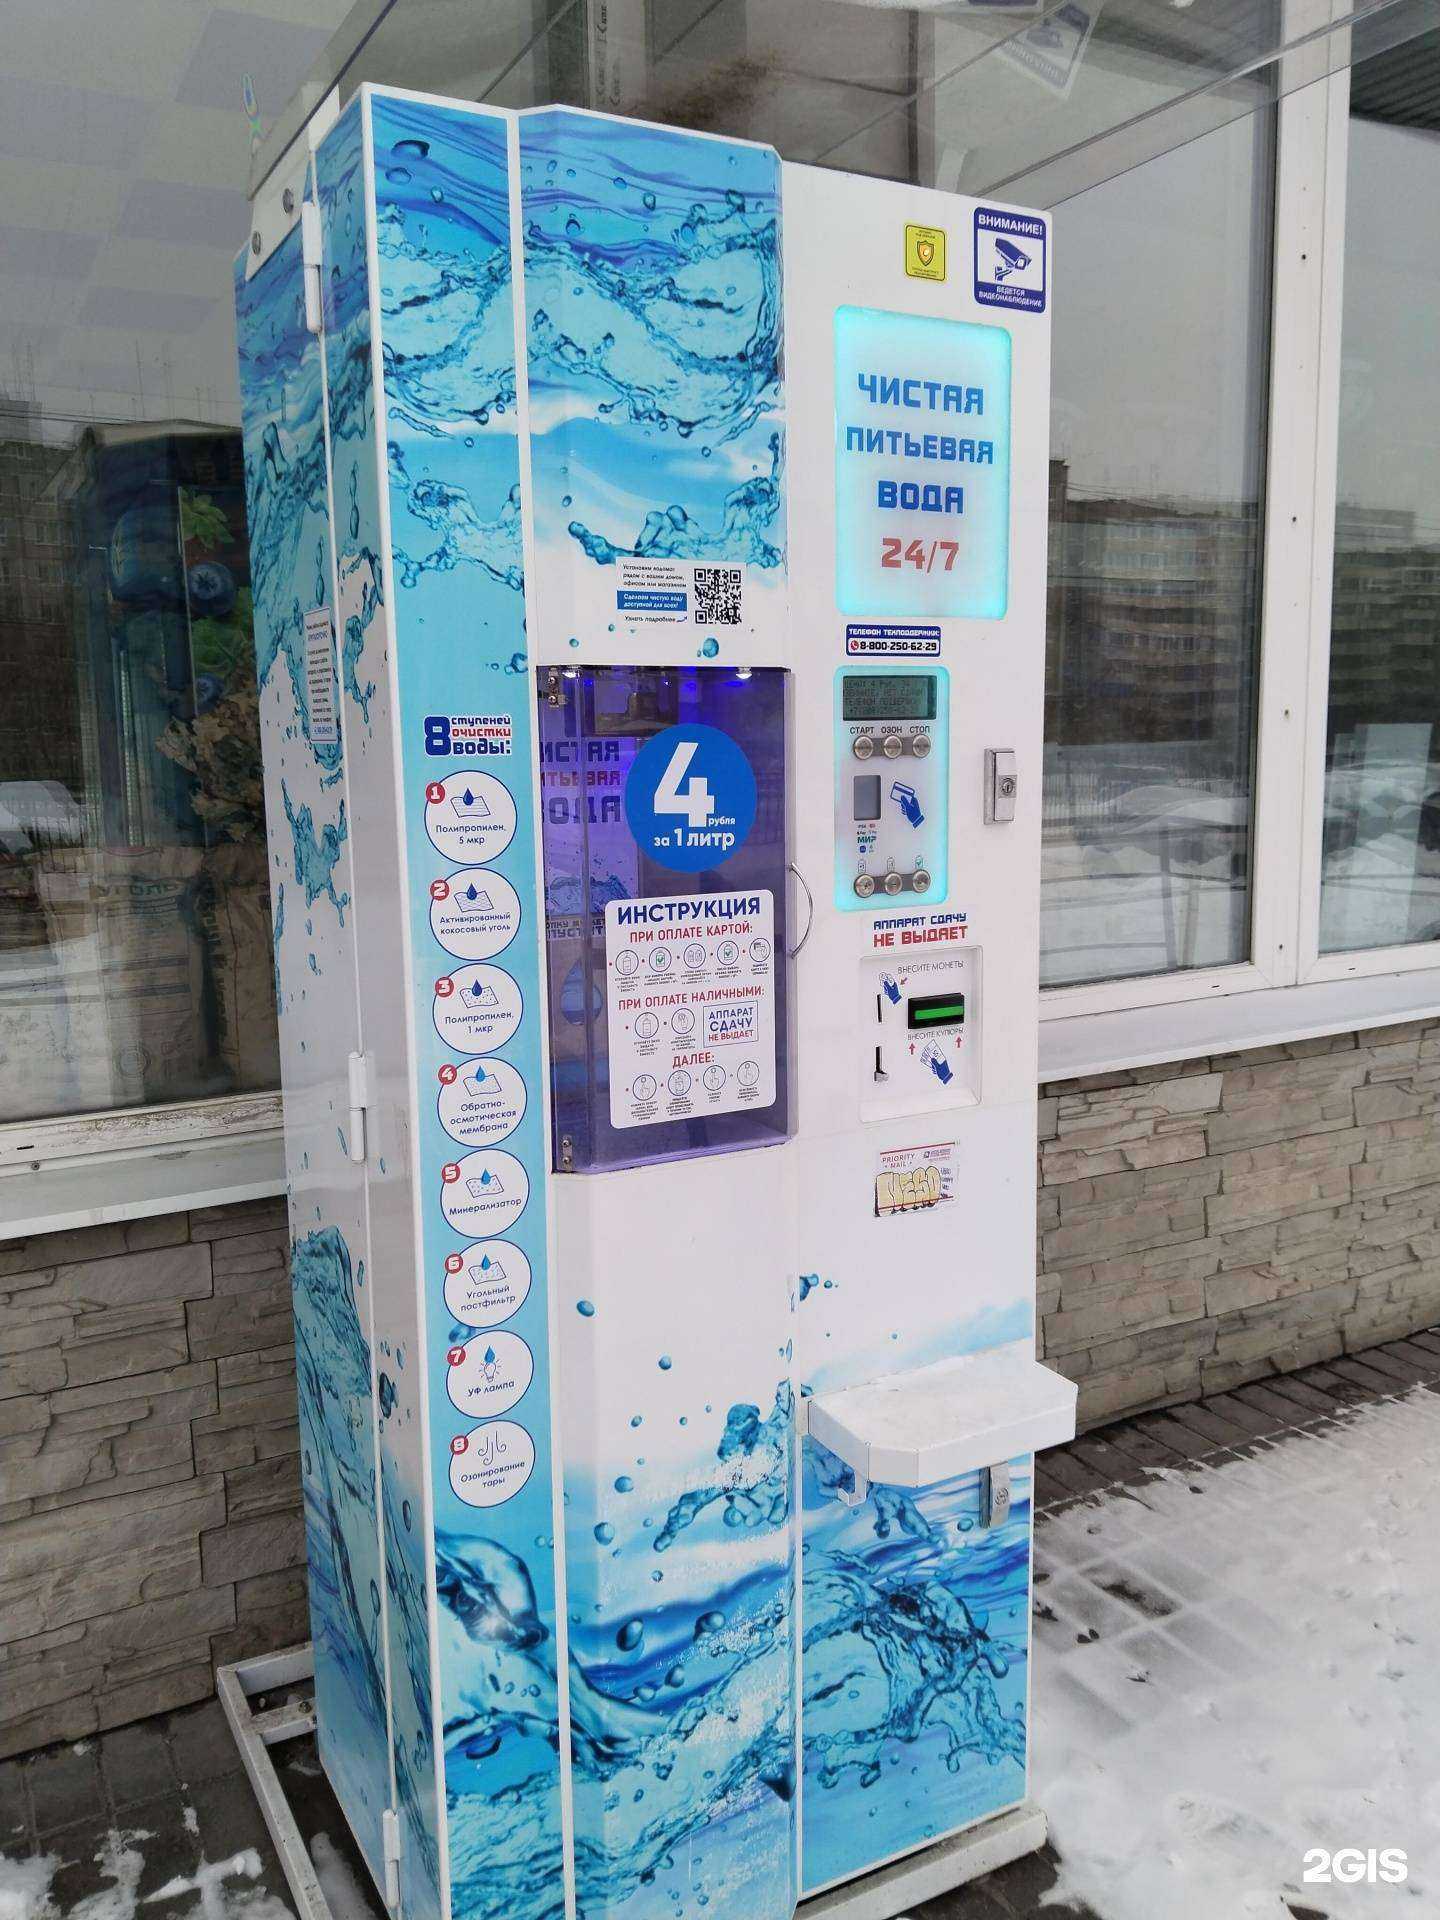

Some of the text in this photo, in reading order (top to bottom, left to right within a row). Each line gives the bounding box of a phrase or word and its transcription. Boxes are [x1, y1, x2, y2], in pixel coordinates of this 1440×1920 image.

[978, 214, 1042, 235] ВНИМАНИЕ!
[858, 373, 984, 415] ЧИСТАЯ
[846, 426, 994, 464] ПИТЬЕВАЯ
[878, 480, 963, 514] ВОДА
[881, 538, 960, 573] 24/7
[860, 641, 937, 651] 8-800-250-62-29
[424, 715, 511, 755] 8 ступеней
[452, 727, 511, 737] очистки
[849, 725, 930, 735] СТАРТ ОЗОН СТОП
[453, 738, 511, 754] воды:
[654, 742, 736, 828] 4 рубля
[430, 786, 440, 800] 1
[467, 837, 485, 845] мкр
[654, 828, 735, 851] за 1 литр
[433, 883, 445, 897] 2
[440, 911, 511, 924] Активированный
[618, 897, 760, 925] ИНСТРУКЦИЯ
[873, 912, 967, 930] АППАРАТ СДАЧУ
[440, 924, 511, 935] кокосовый уголь
[630, 921, 753, 943] ПРИ ОПЛАТЕ КАРТОЙ:
[873, 925, 968, 947] НЕ ВЫДАЕТ
[897, 960, 964, 974] ВНЕСИТЕ МОНЕТЫ
[438, 980, 451, 994] 3
[618, 986, 765, 1010] ПРИ ОПЛАТЕ НАЛИЧНЫМИ:
[708, 1007, 754, 1020] АППАРАТ
[475, 1026, 493, 1034] мкр
[709, 1017, 753, 1032] СДАЧУ
[708, 1029, 754, 1042] НЕ ВЫДАЕТ
[672, 1052, 715, 1069] ДАЛЕЕ:
[441, 1067, 453, 1081] 4
[460, 1099, 505, 1112] Обратно-
[450, 1110, 517, 1126] осмотическая
[459, 1122, 508, 1136] мембрана
[882, 1153, 915, 1162] PRIORITY
[444, 1165, 457, 1180] 5
[449, 1198, 522, 1215] Минерализатор
[447, 1257, 460, 1271] 6
[466, 1284, 510, 1299] Угольный
[460, 1294, 516, 1312] постфильтр
[449, 1349, 461, 1363] 7
[467, 1379, 515, 1397] УФ лампа
[461, 1462, 525, 1483] Озонирование
[483, 1477, 505, 1488] тары
